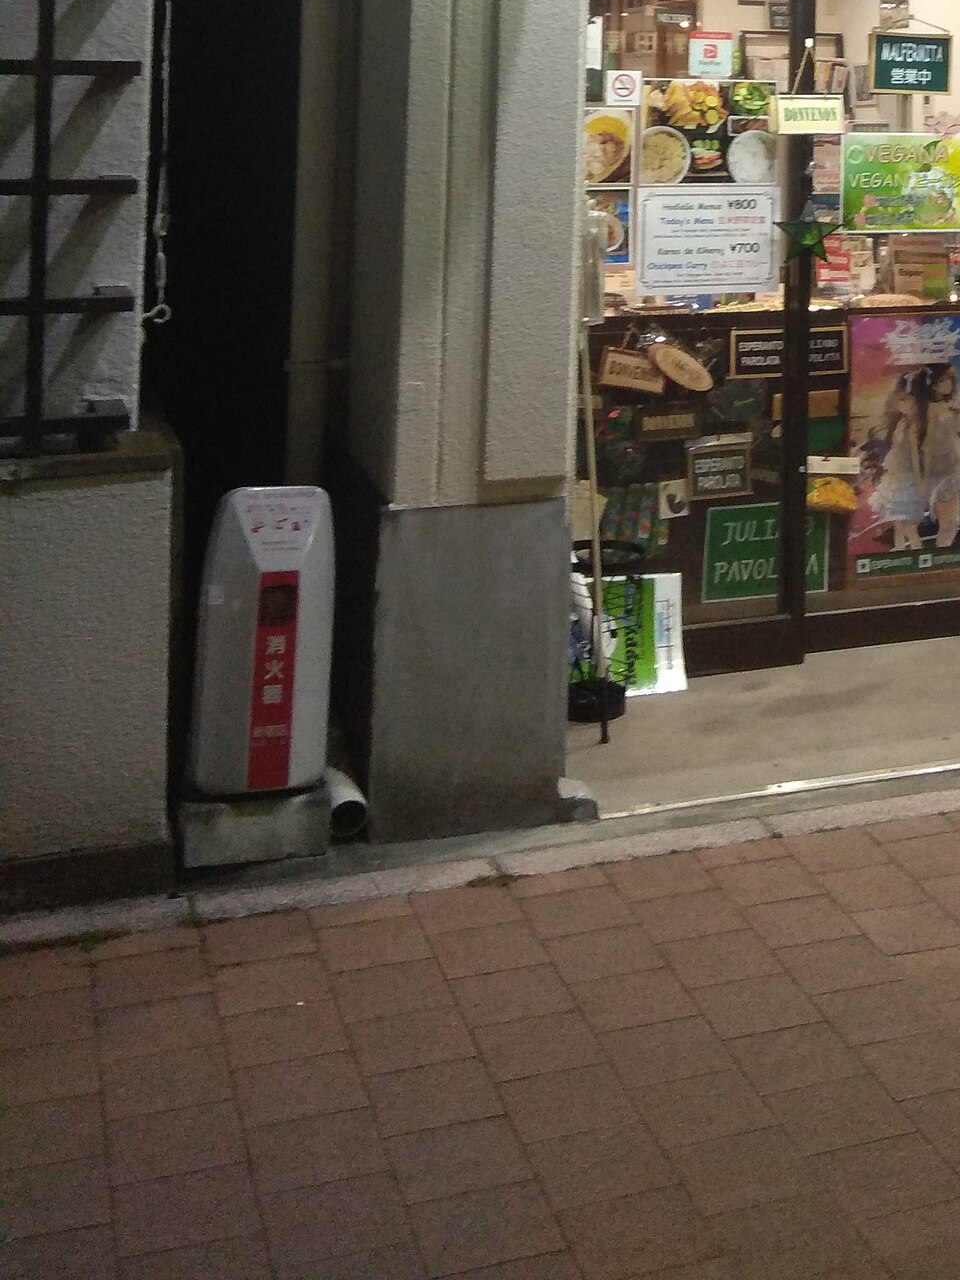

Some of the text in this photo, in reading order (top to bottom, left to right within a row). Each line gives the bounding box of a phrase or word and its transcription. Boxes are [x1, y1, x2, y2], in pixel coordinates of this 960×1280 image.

[890, 67, 932, 85] 営業中
[727, 198, 758, 210] ¥800
[729, 242, 761, 254] ¥700
